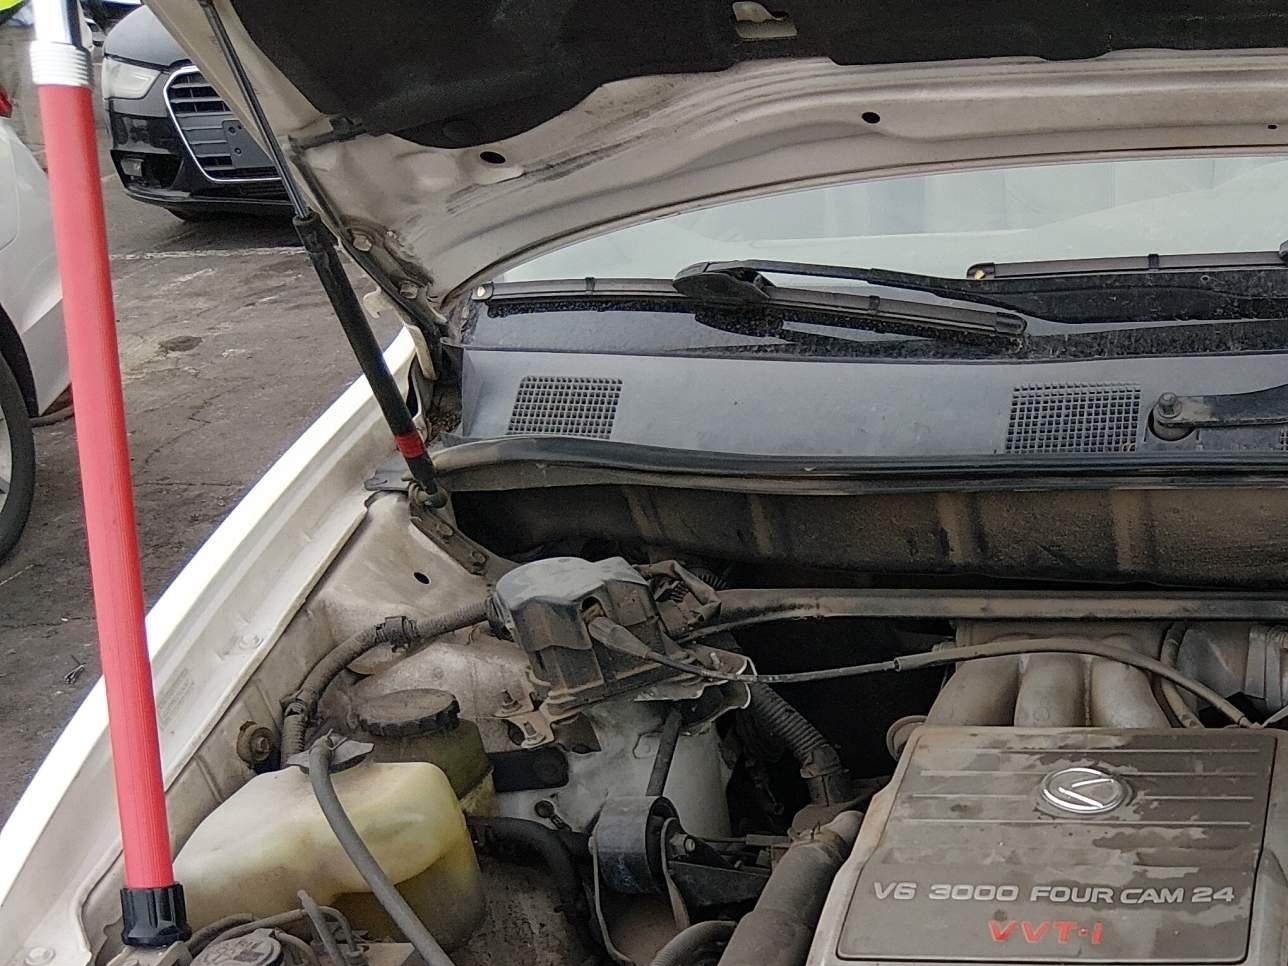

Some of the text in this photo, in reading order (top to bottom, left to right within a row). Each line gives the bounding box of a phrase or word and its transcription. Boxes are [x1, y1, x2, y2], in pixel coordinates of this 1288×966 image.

[873, 882, 1235, 904] V6 3000 FOUR CAM 24
